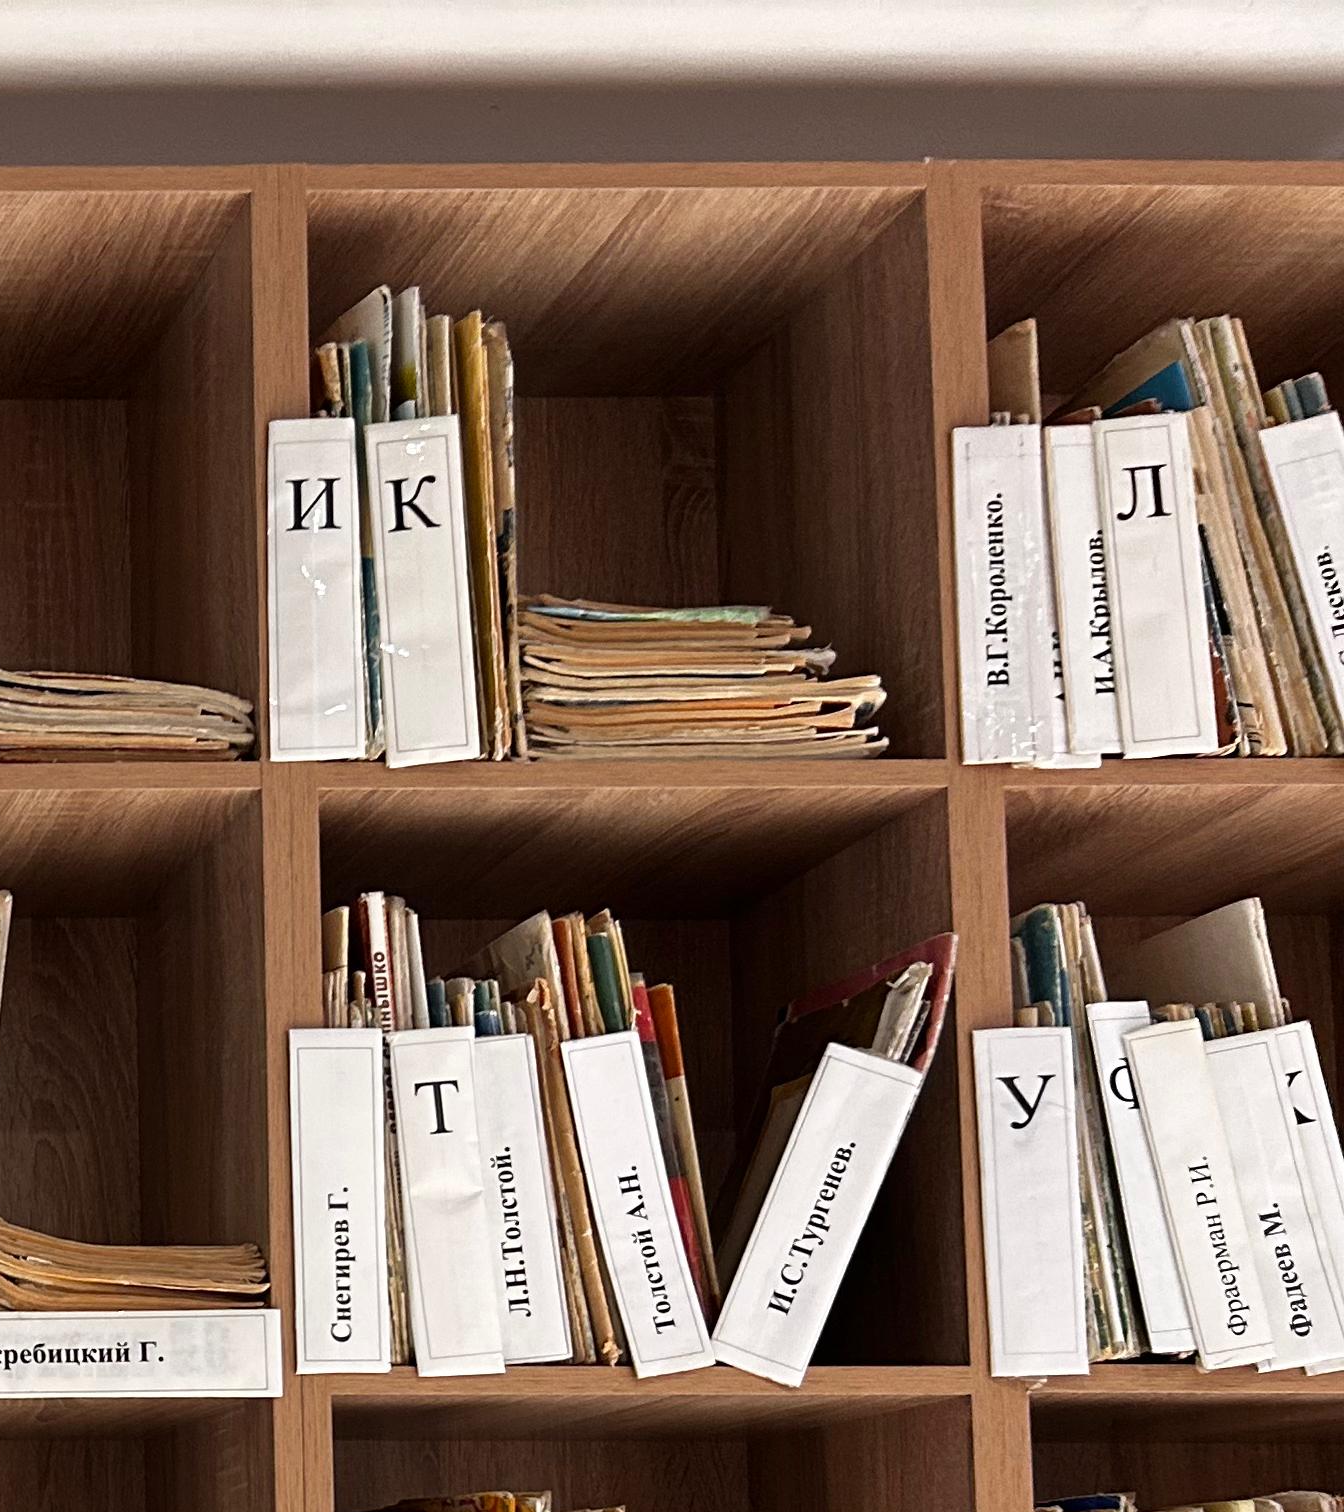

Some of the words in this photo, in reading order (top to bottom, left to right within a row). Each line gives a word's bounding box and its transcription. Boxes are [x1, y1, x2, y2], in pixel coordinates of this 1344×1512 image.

[286, 477, 342, 532] И
[385, 474, 441, 533] К
[1116, 464, 1172, 521] Л
[985, 492, 1012, 686] В.Г.Короленко.
[1088, 529, 1113, 696] И.А.Крылов.
[414, 1079, 460, 1135] Т
[995, 1074, 1057, 1130] У
[328, 1186, 350, 1213] Г.
[617, 1164, 651, 1220] А.Н.
[1188, 1155, 1218, 1206] Р.И.
[487, 1145, 532, 1317] Л.Н.Толстой.
[766, 1140, 858, 1316] И.С.Тургенев.
[1258, 1202, 1290, 1238] М.
[330, 1219, 359, 1344] Снегирев
[633, 1233, 677, 1335] Толстой
[1203, 1213, 1249, 1336] Фраерман
[1274, 1243, 1314, 1338] Фадеев
[139, 1341, 165, 1365] Г.
